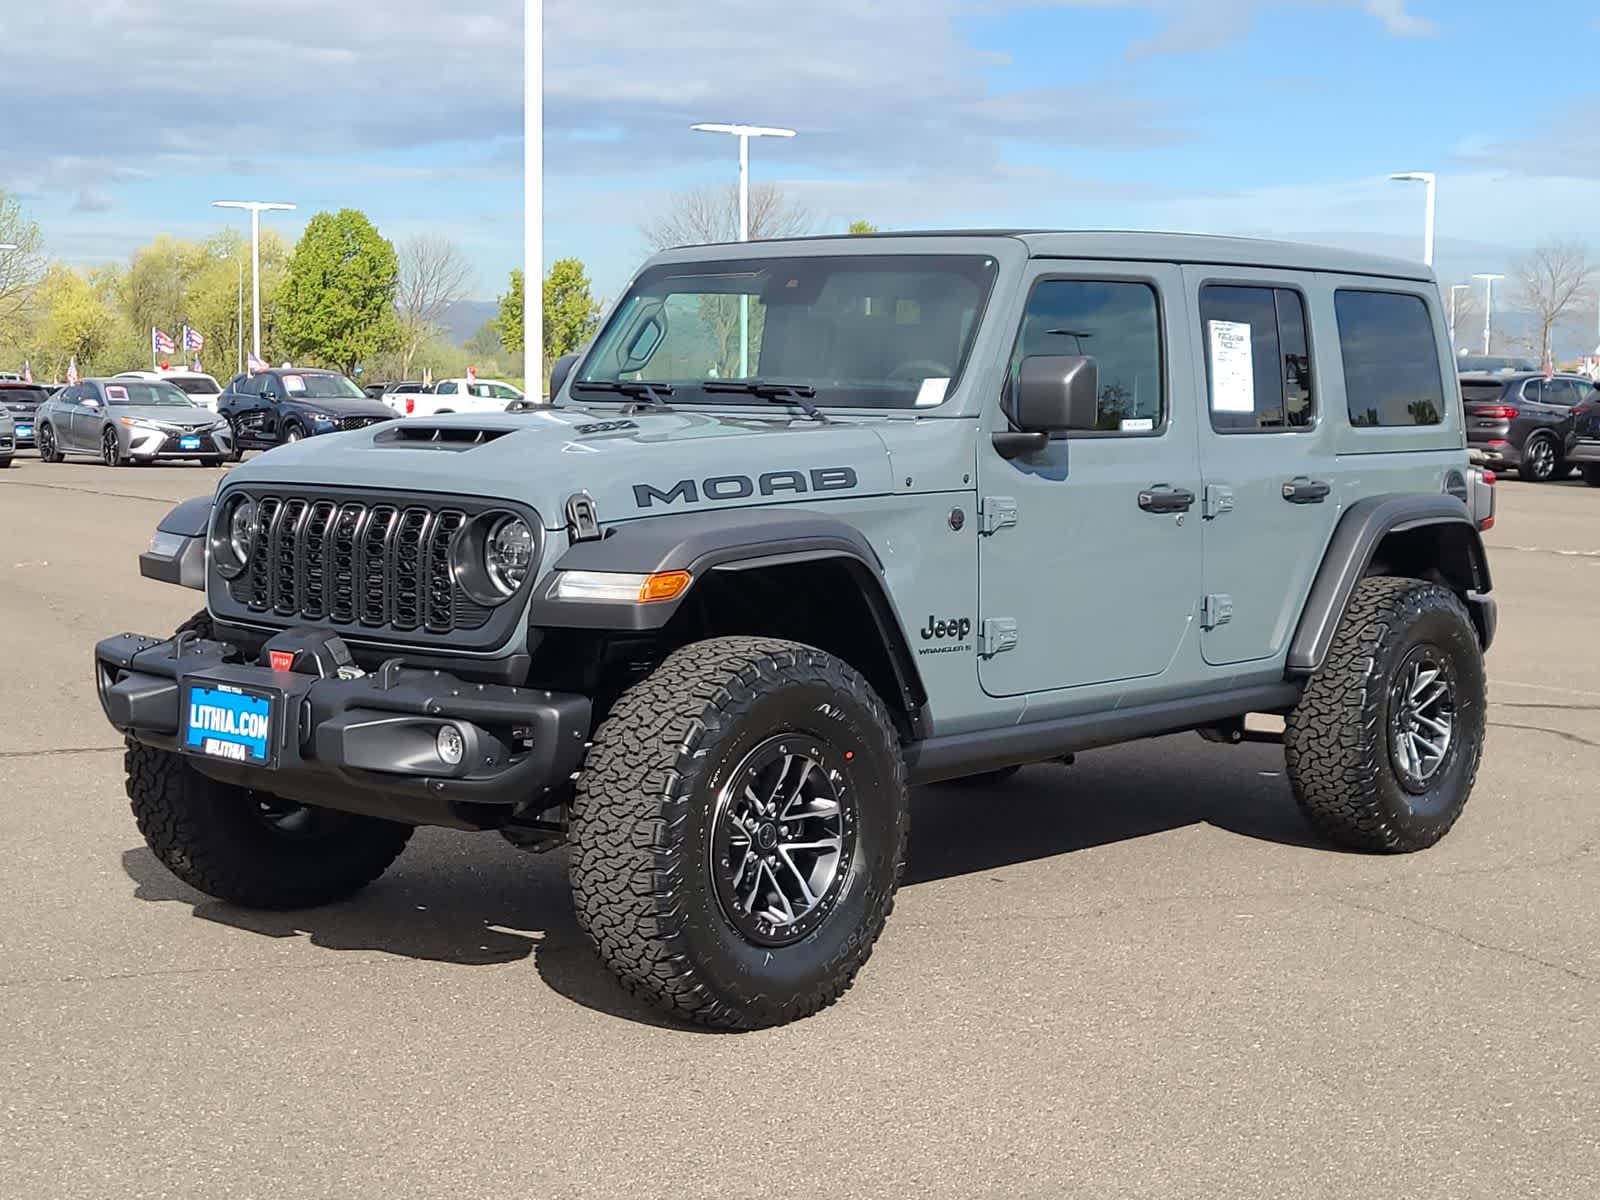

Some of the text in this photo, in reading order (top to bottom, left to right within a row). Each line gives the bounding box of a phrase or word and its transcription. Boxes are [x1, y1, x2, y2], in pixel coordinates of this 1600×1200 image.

[632, 467, 857, 507] MOAB
[920, 615, 970, 641] Jeep
[190, 703, 269, 740] LITHIA.COM
